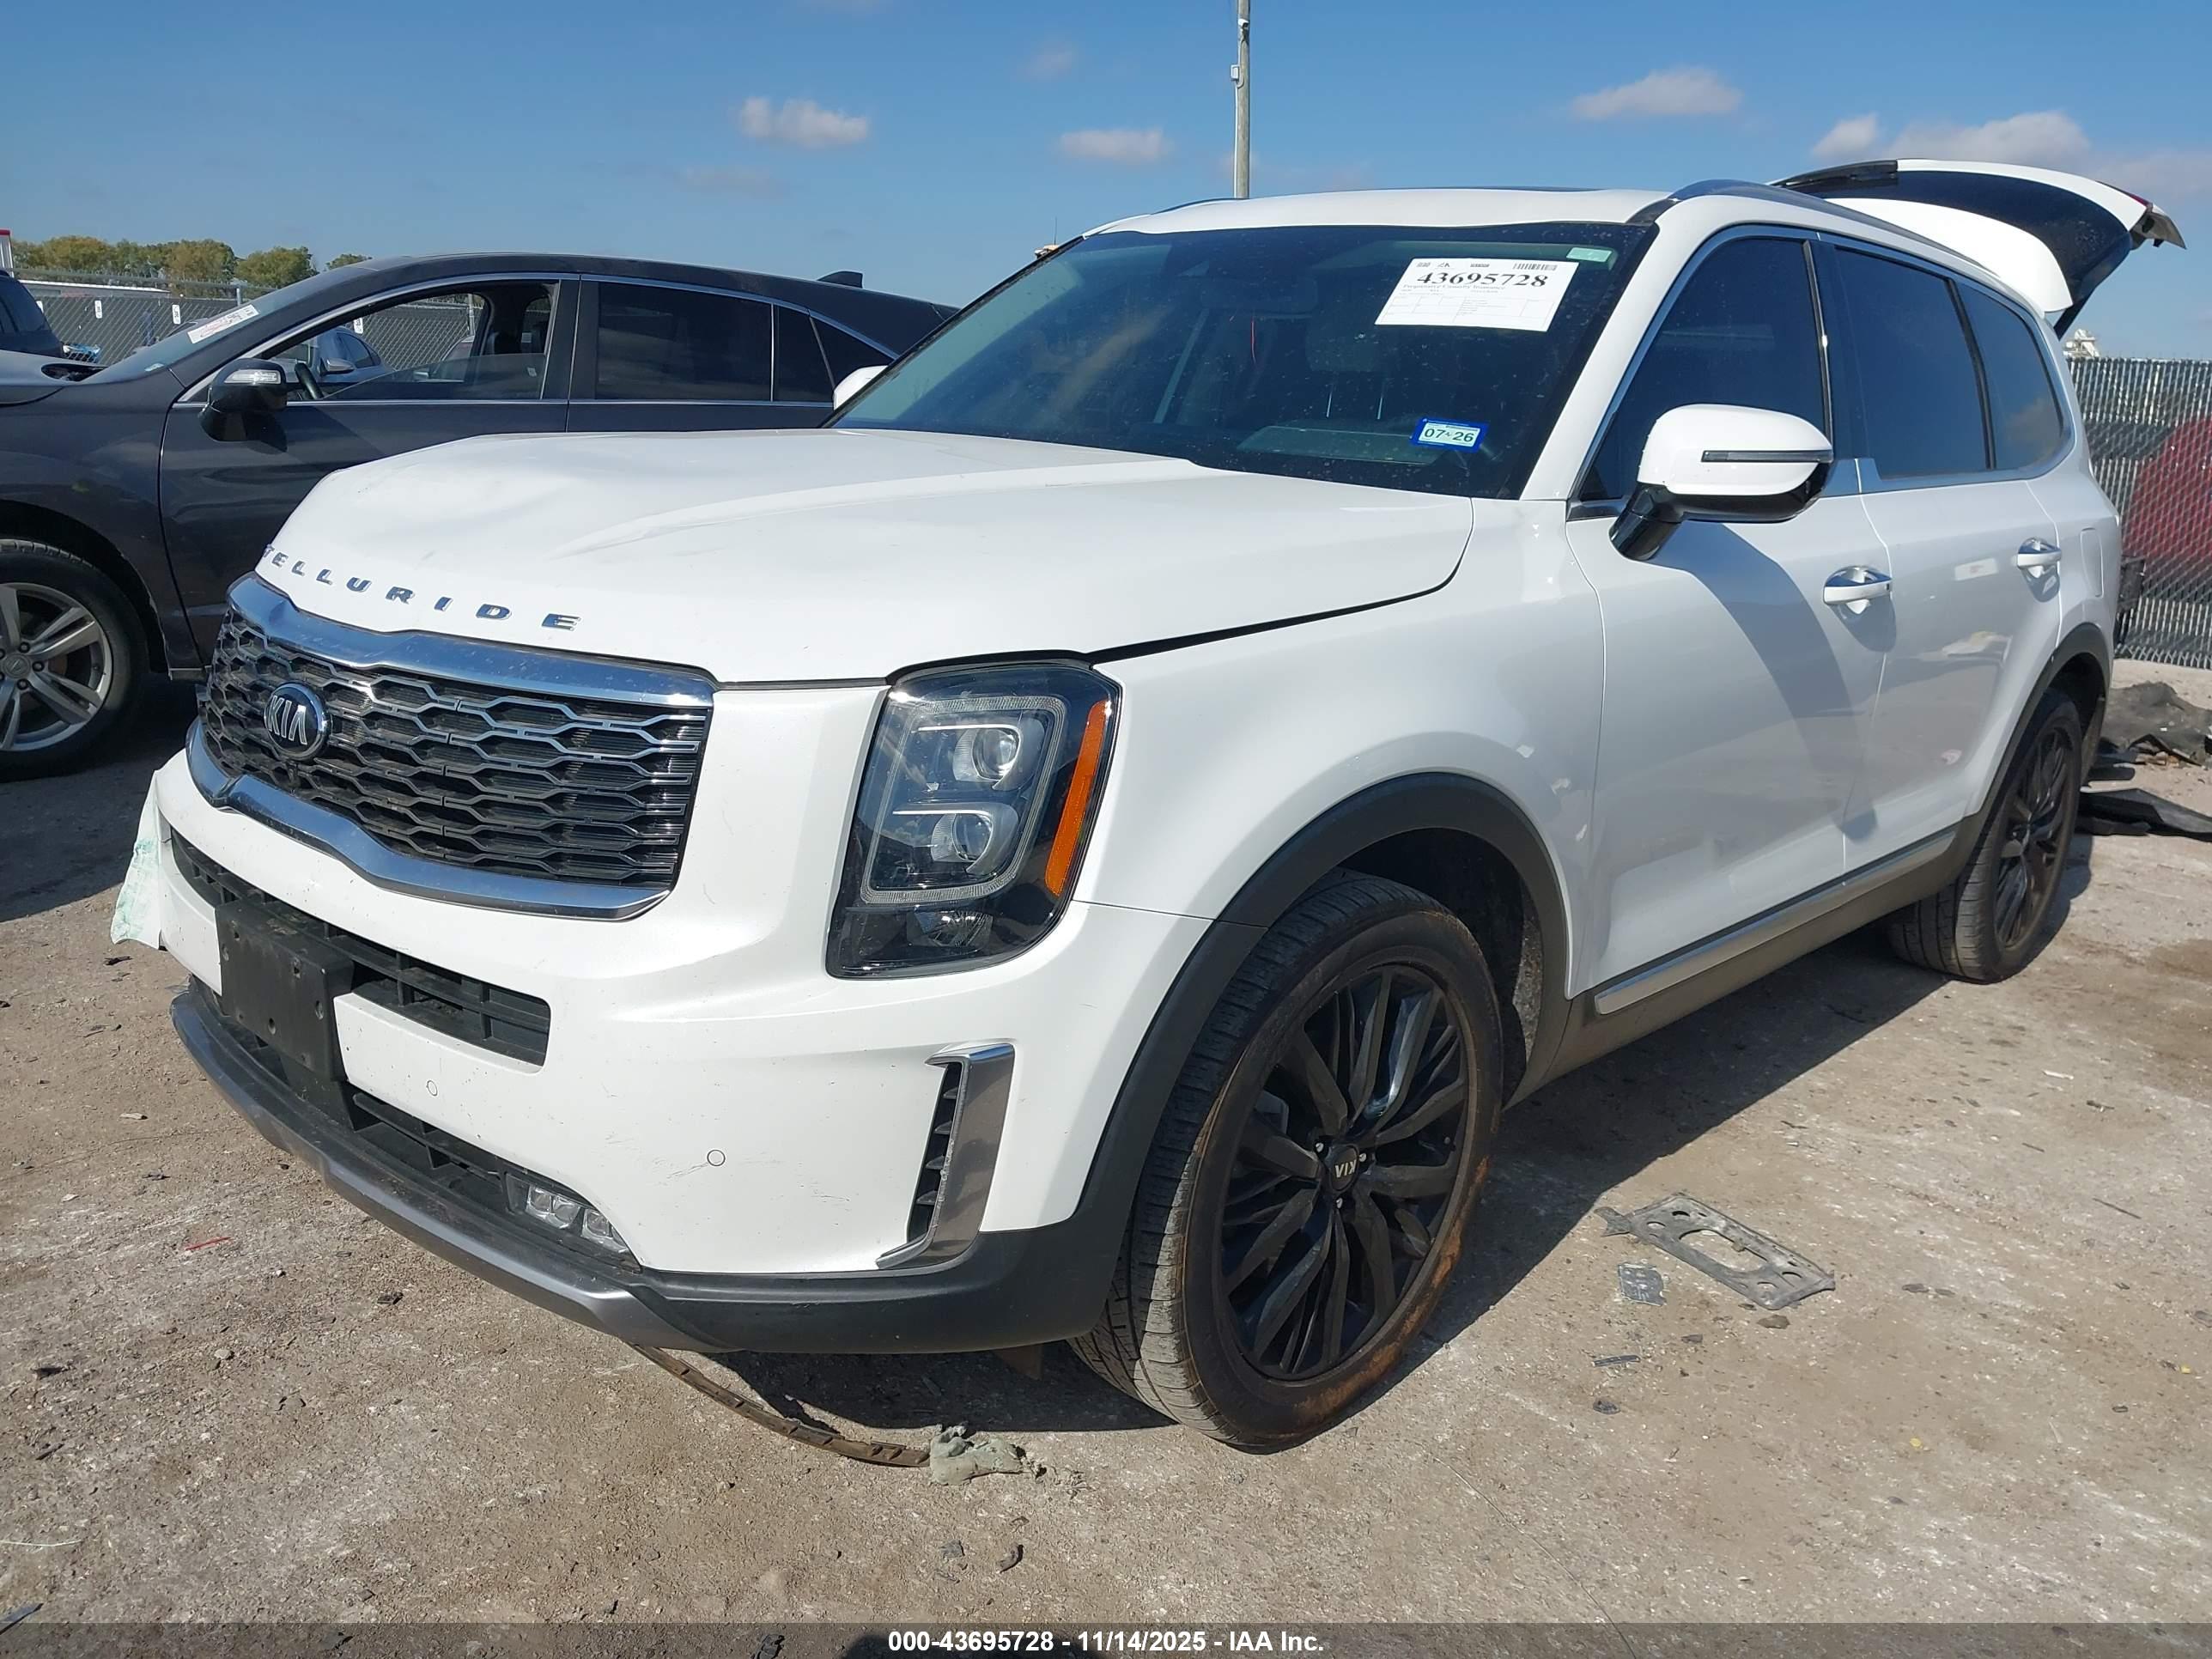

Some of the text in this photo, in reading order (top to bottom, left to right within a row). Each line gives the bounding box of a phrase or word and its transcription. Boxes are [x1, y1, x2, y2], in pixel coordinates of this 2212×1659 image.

[1417, 271, 1549, 288] 43695728
[263, 544, 582, 631] TELLURIDE
[268, 695, 307, 745] KIA
[1334, 1159, 1357, 1178] KIA
